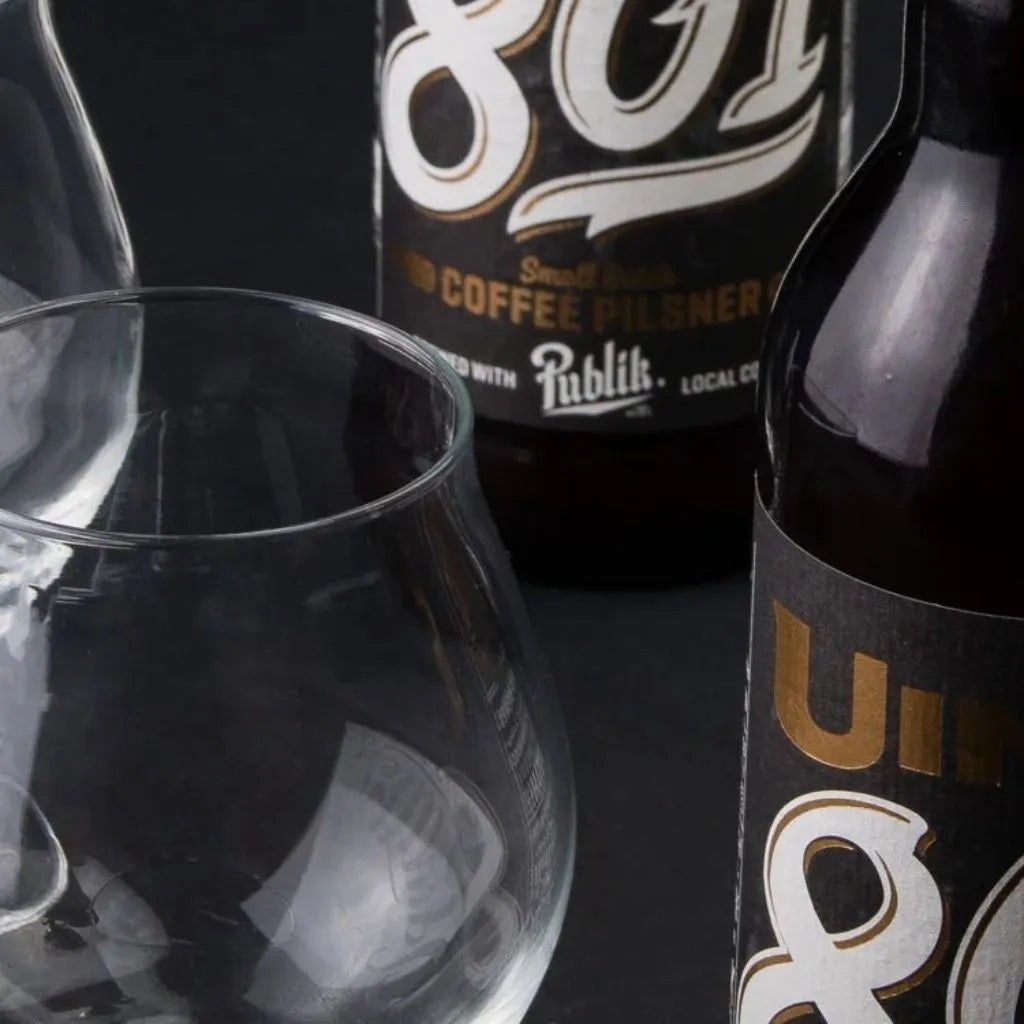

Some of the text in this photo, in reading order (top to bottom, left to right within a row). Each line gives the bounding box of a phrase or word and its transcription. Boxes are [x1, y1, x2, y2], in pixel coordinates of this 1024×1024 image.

[441, 266, 581, 331] COFFEE
[594, 279, 761, 334] PILSNER
[470, 360, 518, 390] WITH
[530, 339, 653, 412] Publik
[680, 368, 738, 396] LOCAL
